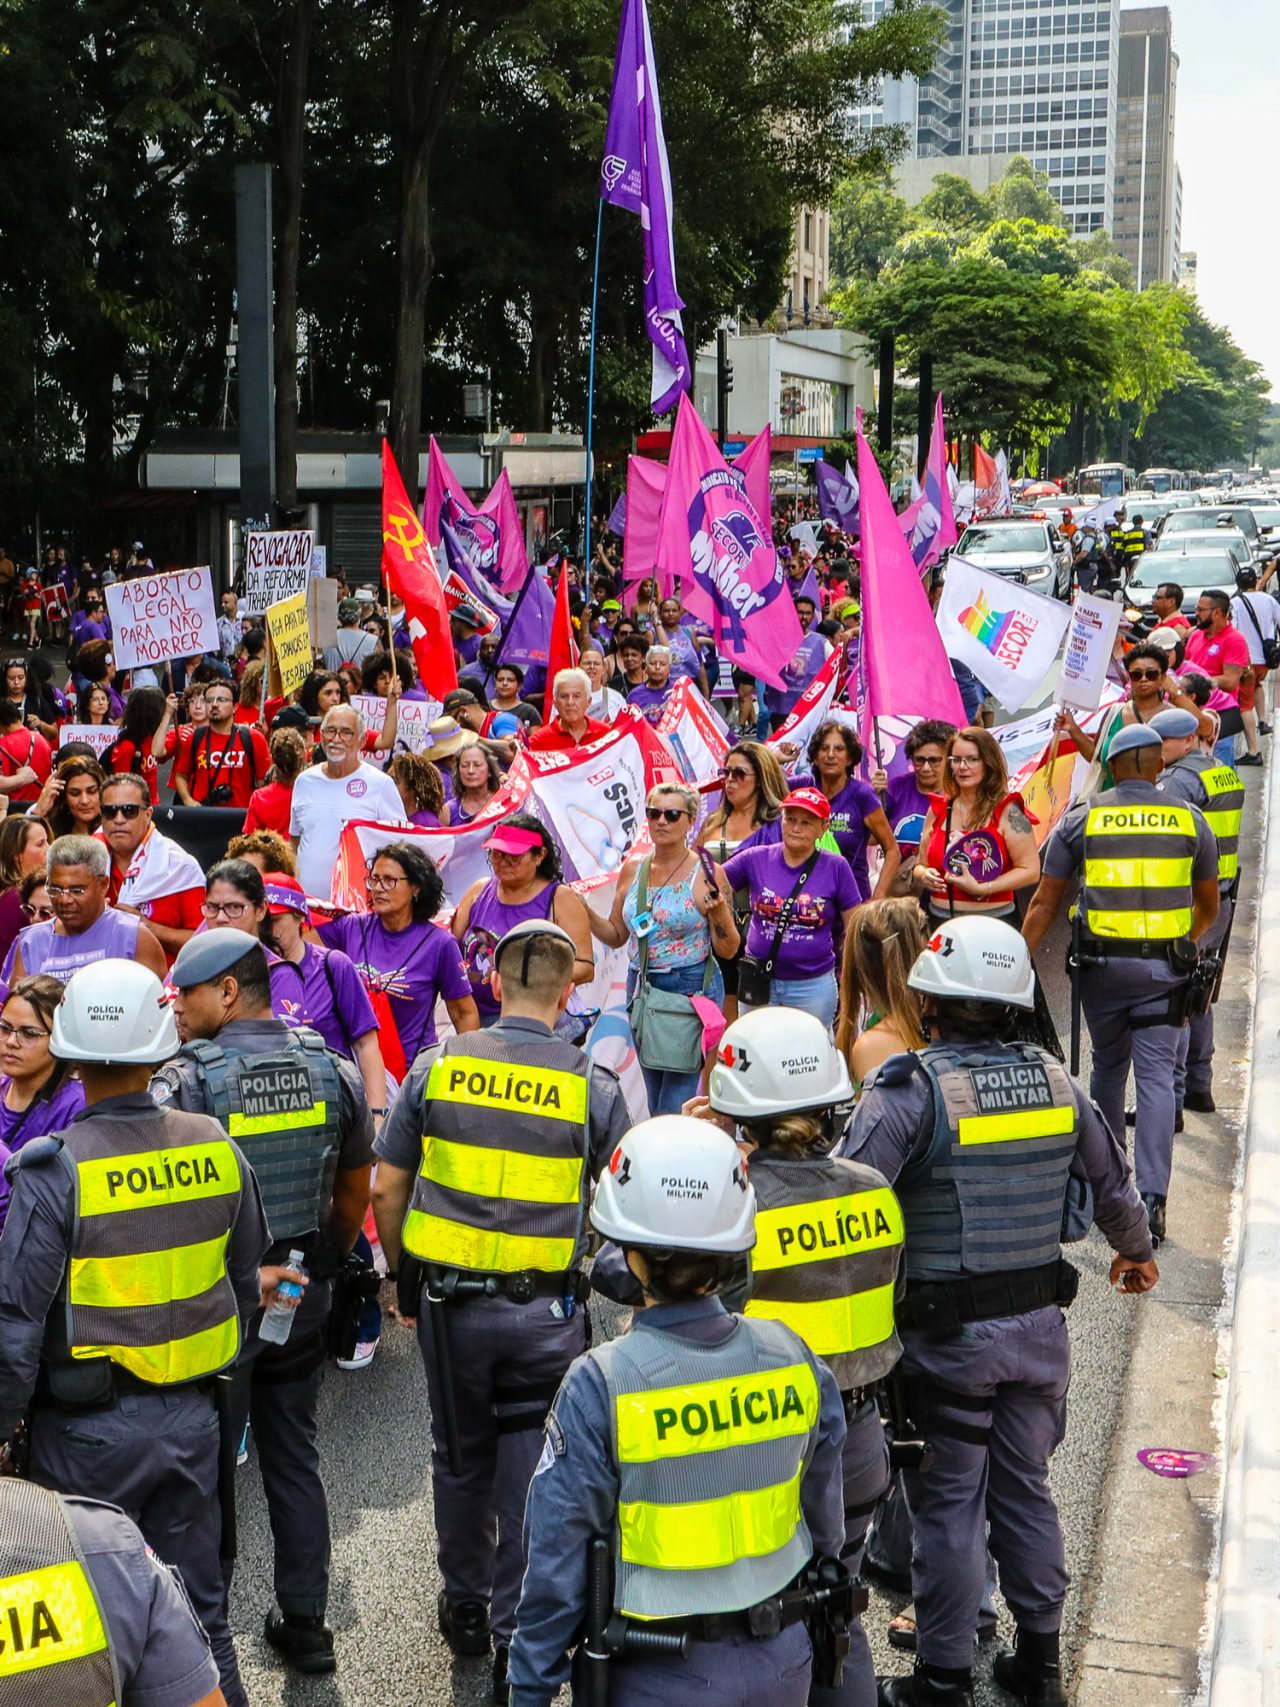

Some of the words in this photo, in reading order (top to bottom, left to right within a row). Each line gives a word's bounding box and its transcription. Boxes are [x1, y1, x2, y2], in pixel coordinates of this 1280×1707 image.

[248, 532, 312, 569] REVOGAÇÃO
[711, 521, 746, 564] SECOR
[247, 571, 259, 591] DA
[263, 569, 306, 590] REFORMA
[690, 530, 766, 619] Mulher
[121, 571, 202, 604] ABORTO
[132, 594, 195, 622] LEGAL
[120, 622, 155, 646] PARA
[169, 612, 203, 635] NÃO
[136, 631, 204, 663] MORRER
[67, 733, 82, 743] FIM
[84, 734, 95, 743] DO
[98, 733, 119, 744] PAGA
[1103, 810, 1179, 828] POLÍCIA
[982, 951, 1016, 964] POLÍCIA
[986, 959, 1012, 970] MILITAR
[87, 1004, 124, 1015] POLÍCIA
[90, 1014, 120, 1022] MILITAR
[781, 1055, 819, 1069] POLÍCIA
[788, 1065, 817, 1075] MILITAR
[242, 1072, 308, 1095] POLÍCIA
[450, 1069, 561, 1109] POLÍCIA
[975, 1066, 1047, 1090] POLÍCIA
[245, 1092, 312, 1115] MILITAR
[980, 1086, 1050, 1110] MILITAR
[106, 1156, 220, 1197] POLÍCIA
[661, 1177, 709, 1191] POLÍCIA
[667, 1190, 703, 1200] MILITAR
[777, 1208, 891, 1256] POLÍCIA
[654, 1385, 804, 1440] POLÍCIA
